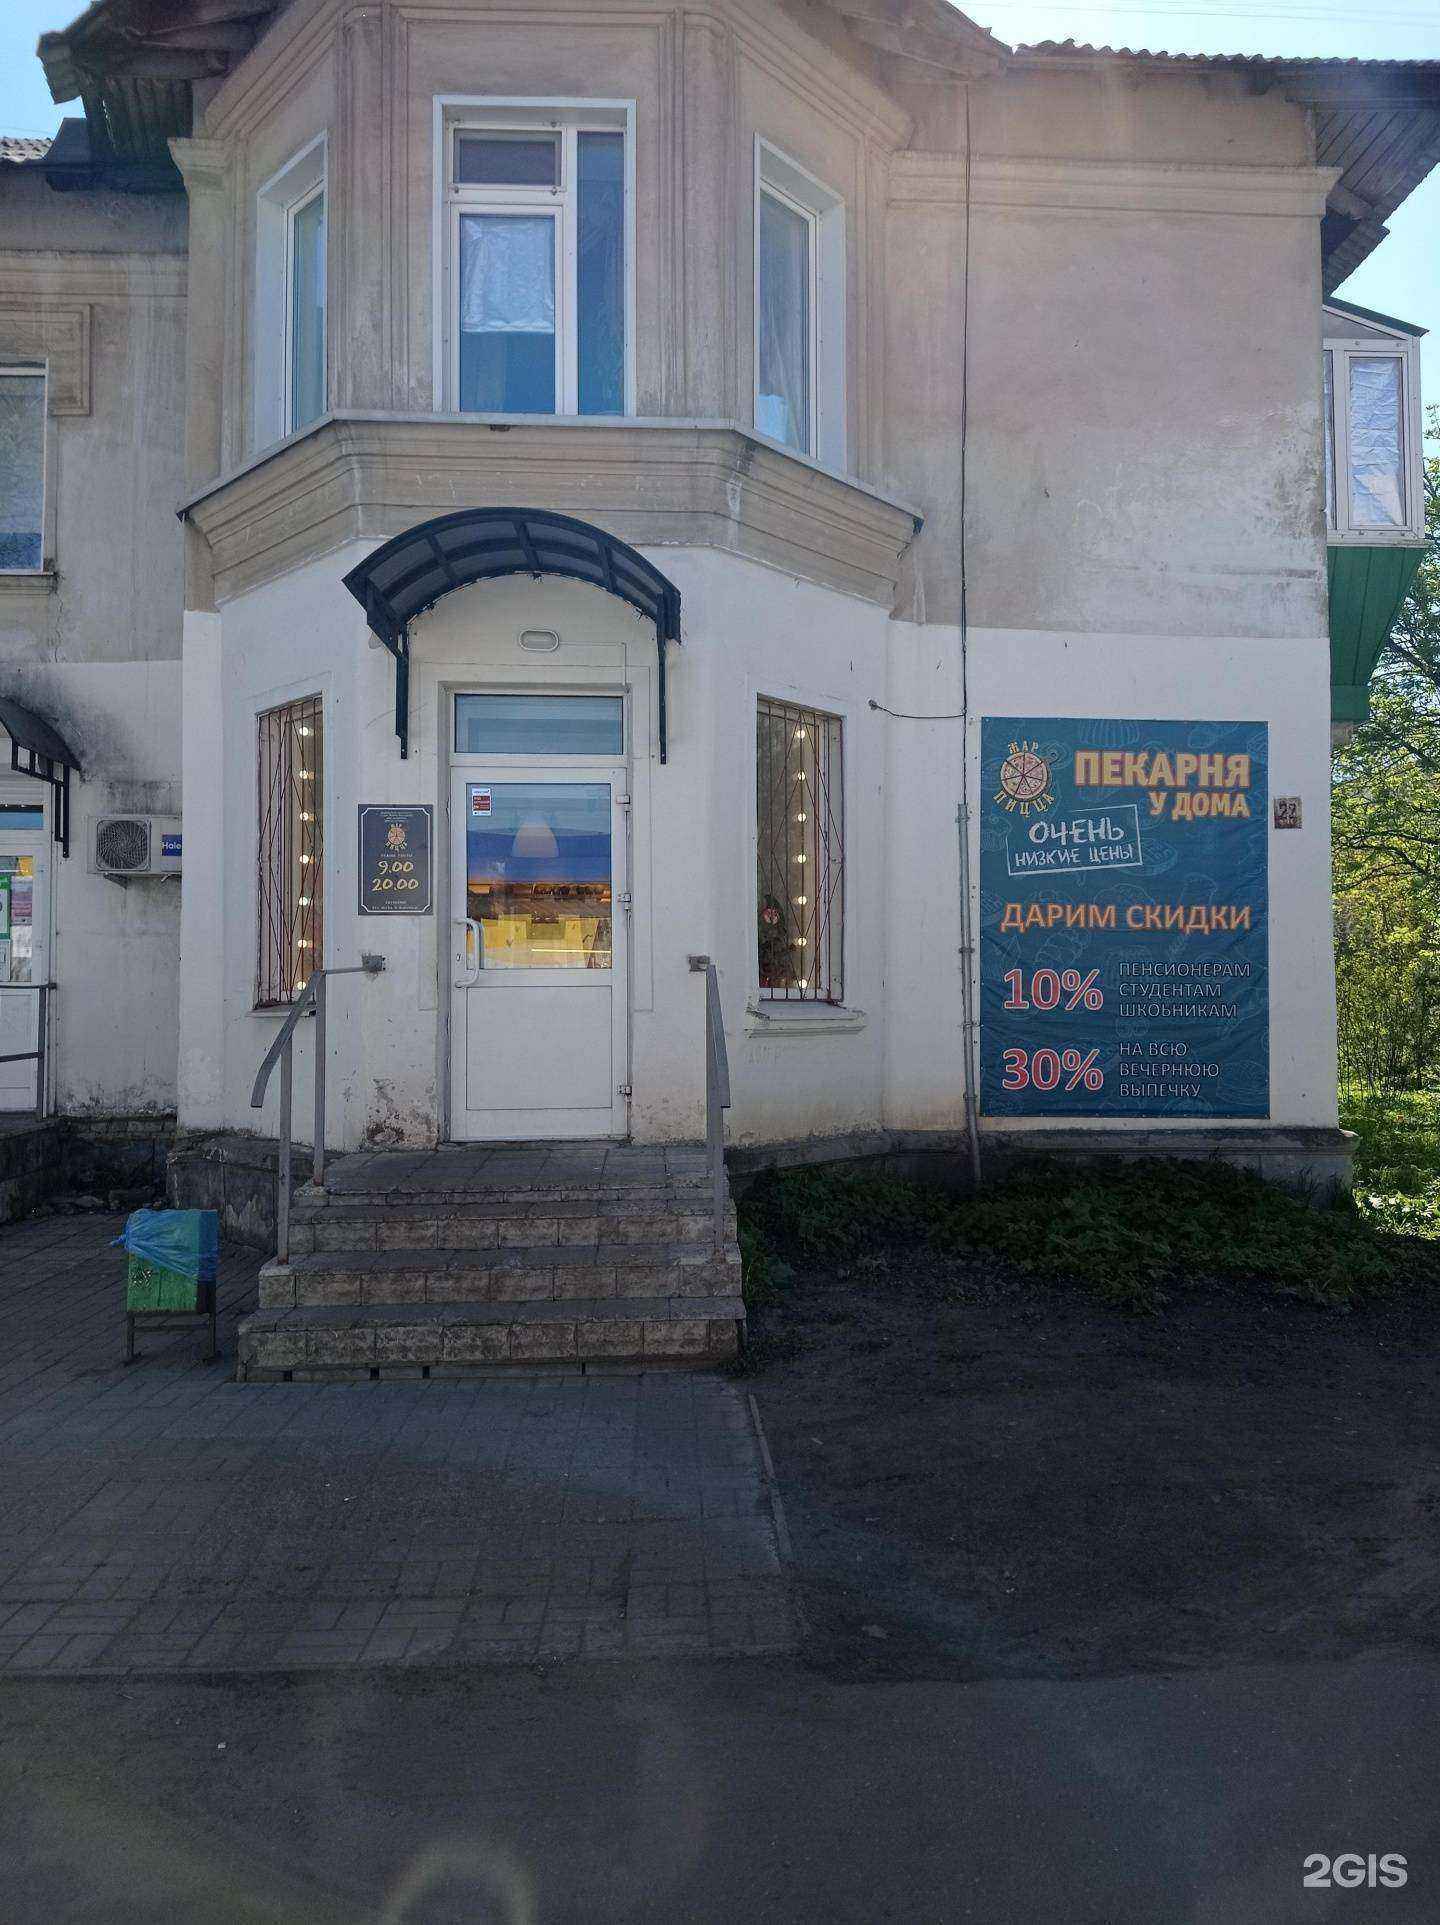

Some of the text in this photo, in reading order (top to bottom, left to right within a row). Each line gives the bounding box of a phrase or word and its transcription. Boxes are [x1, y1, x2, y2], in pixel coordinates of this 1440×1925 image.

[1075, 751, 1251, 788] ПЕКАРНЯ
[993, 789, 1055, 818] ПИЦЦА
[1149, 792, 1251, 821] У ДОМА
[1028, 817, 1125, 846] ОЧЕНЬ
[1015, 843, 1133, 867] НИЗКИЕ ЦЕНЫ
[1000, 903, 1252, 935] ДАРИМ СКИДКИ
[1119, 963, 1251, 978] ПЕНСИОНЕРАМ
[1003, 968, 1105, 1011] 10%
[1119, 983, 1222, 1000] СТУДЕНТАМ
[1119, 1042, 1187, 1056] НА ВСЮ
[1002, 1048, 1105, 1091] 30%
[1119, 1063, 1220, 1077] ВЕЧЕРНЮЮ
[1119, 1083, 1201, 1098] ВЫПЕЧКУ
